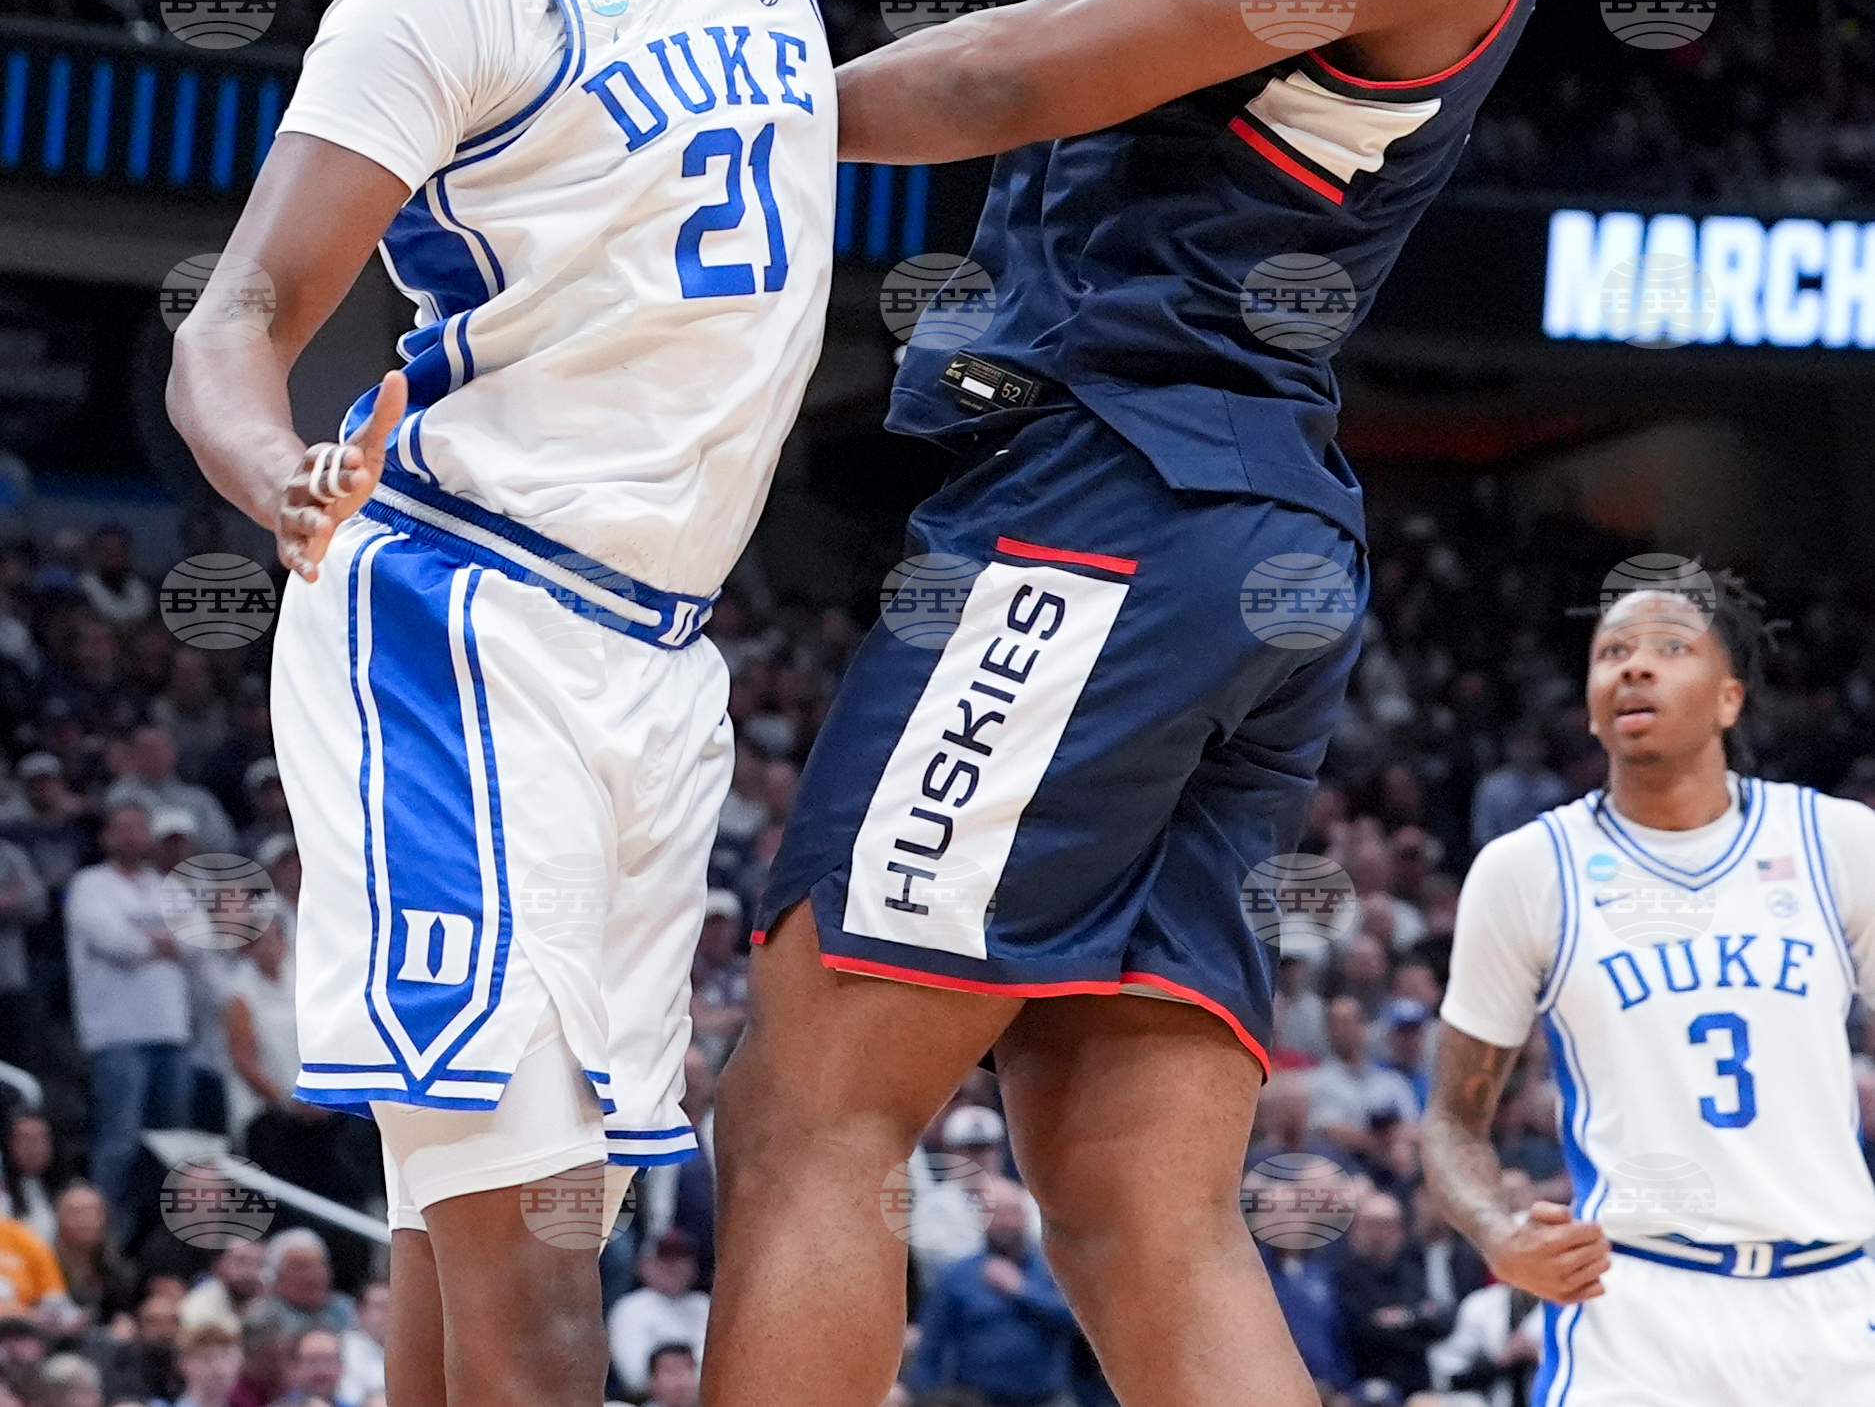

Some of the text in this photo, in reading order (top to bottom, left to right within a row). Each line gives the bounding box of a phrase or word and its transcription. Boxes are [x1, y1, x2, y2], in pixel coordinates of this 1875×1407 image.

[581, 26, 814, 153] DUKE
[674, 122, 789, 299] 21
[1542, 208, 1875, 350] MARCH
[1001, 382, 1021, 403] 52
[884, 583, 1066, 916] HUSKIES
[398, 909, 474, 985] D
[1598, 934, 1815, 1011] DUKE
[1688, 1011, 1757, 1128] 3
